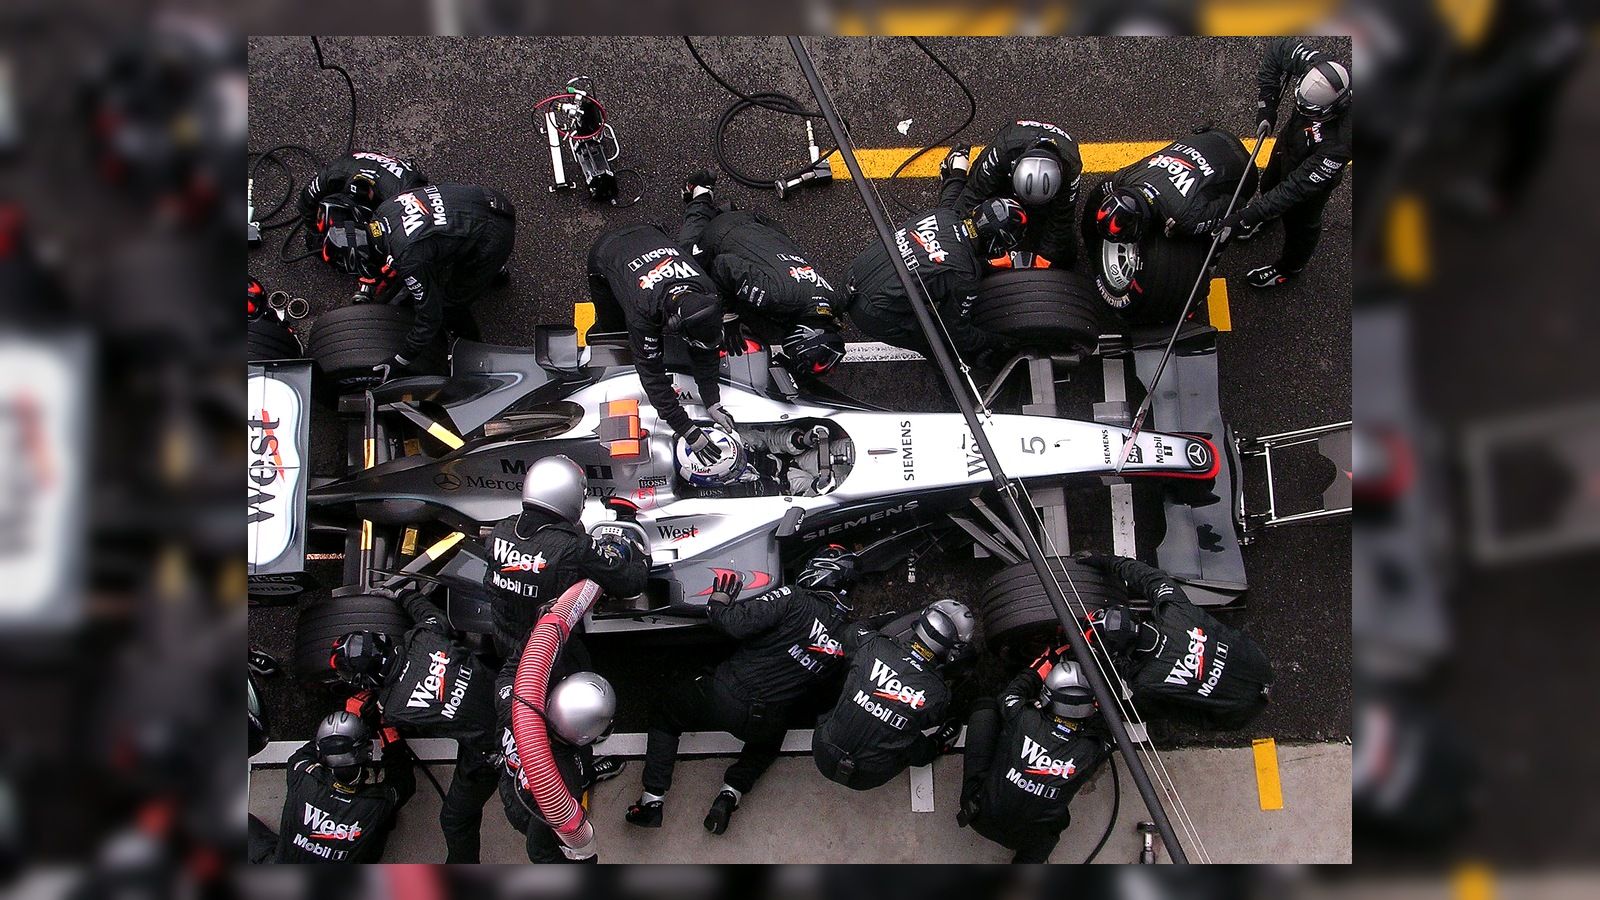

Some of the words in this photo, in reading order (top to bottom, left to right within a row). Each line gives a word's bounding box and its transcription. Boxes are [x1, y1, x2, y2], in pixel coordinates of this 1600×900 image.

[1148, 154, 1195, 197] West
[1184, 145, 1214, 177] Mobil
[394, 192, 425, 236] West
[427, 192, 448, 226] Mobil
[642, 248, 679, 263] Mobil
[916, 214, 949, 264] West
[639, 260, 700, 290] West
[789, 265, 834, 292] West
[900, 420, 915, 481] SIEMENS
[1021, 436, 1046, 455] 5
[1101, 429, 1112, 465] SIEMENS
[1153, 436, 1164, 464] Mobil
[641, 478, 667, 489] BOSS
[700, 487, 723, 497] BOSS
[657, 524, 697, 540] West
[803, 500, 920, 541] SIEMENS
[494, 537, 546, 573] West
[493, 571, 521, 594] Mobil
[808, 617, 844, 658] West
[1164, 627, 1207, 686] West
[406, 650, 450, 709] West
[869, 658, 926, 709] West
[1198, 658, 1226, 697] Mobil
[441, 677, 468, 719] Mobil
[853, 690, 893, 721] Mobil
[1021, 736, 1076, 779] West
[1005, 768, 1045, 796] Mobil
[304, 802, 362, 841] West
[293, 834, 332, 859] Mobil
